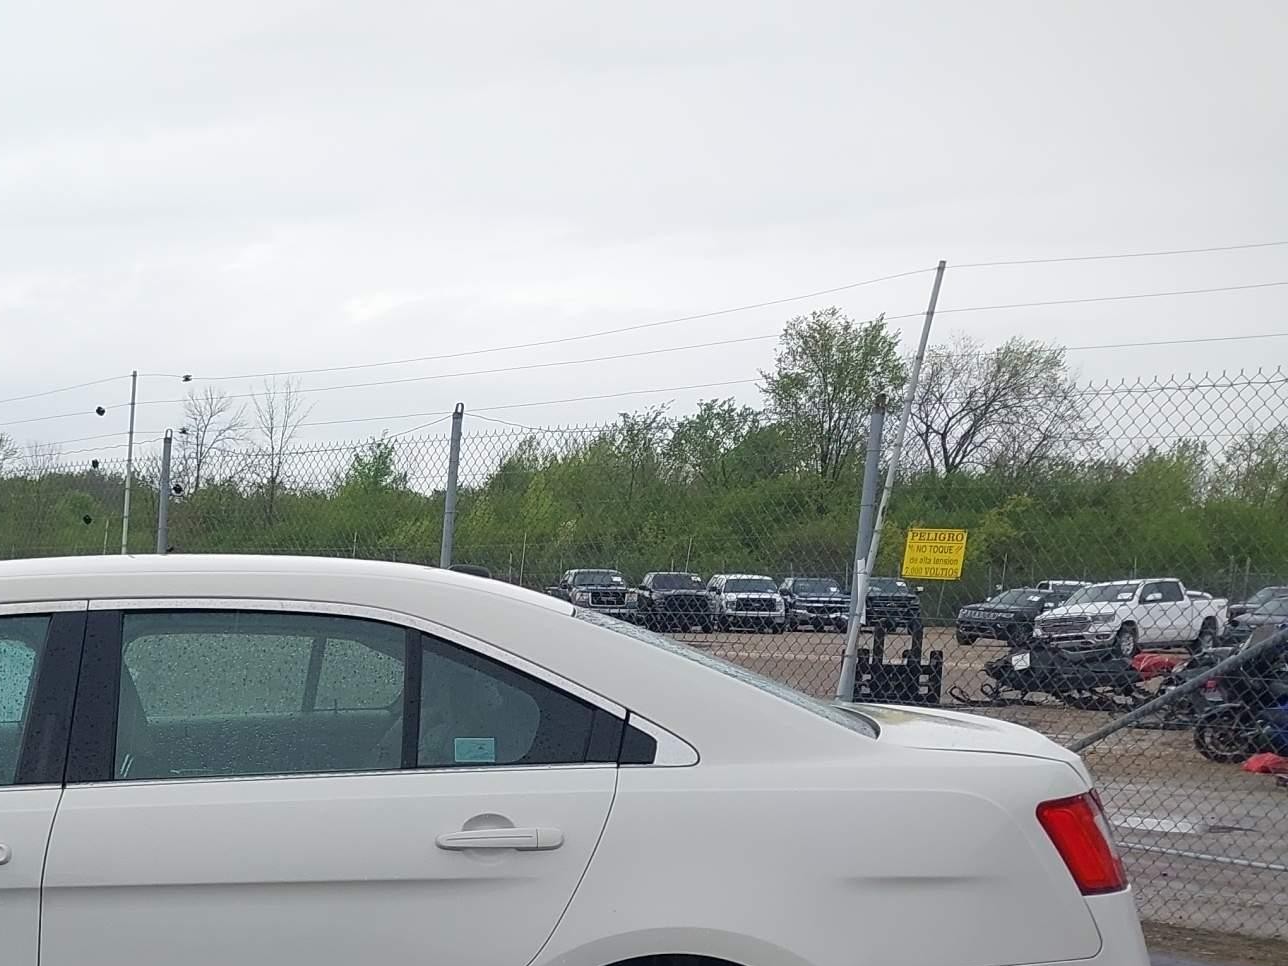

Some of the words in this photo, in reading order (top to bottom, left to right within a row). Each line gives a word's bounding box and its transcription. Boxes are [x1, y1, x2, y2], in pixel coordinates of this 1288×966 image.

[911, 532, 964, 542] PELIGRO
[916, 545, 927, 553] NO
[928, 545, 953, 554] TOQUE
[925, 567, 959, 576] VOLTIOS
